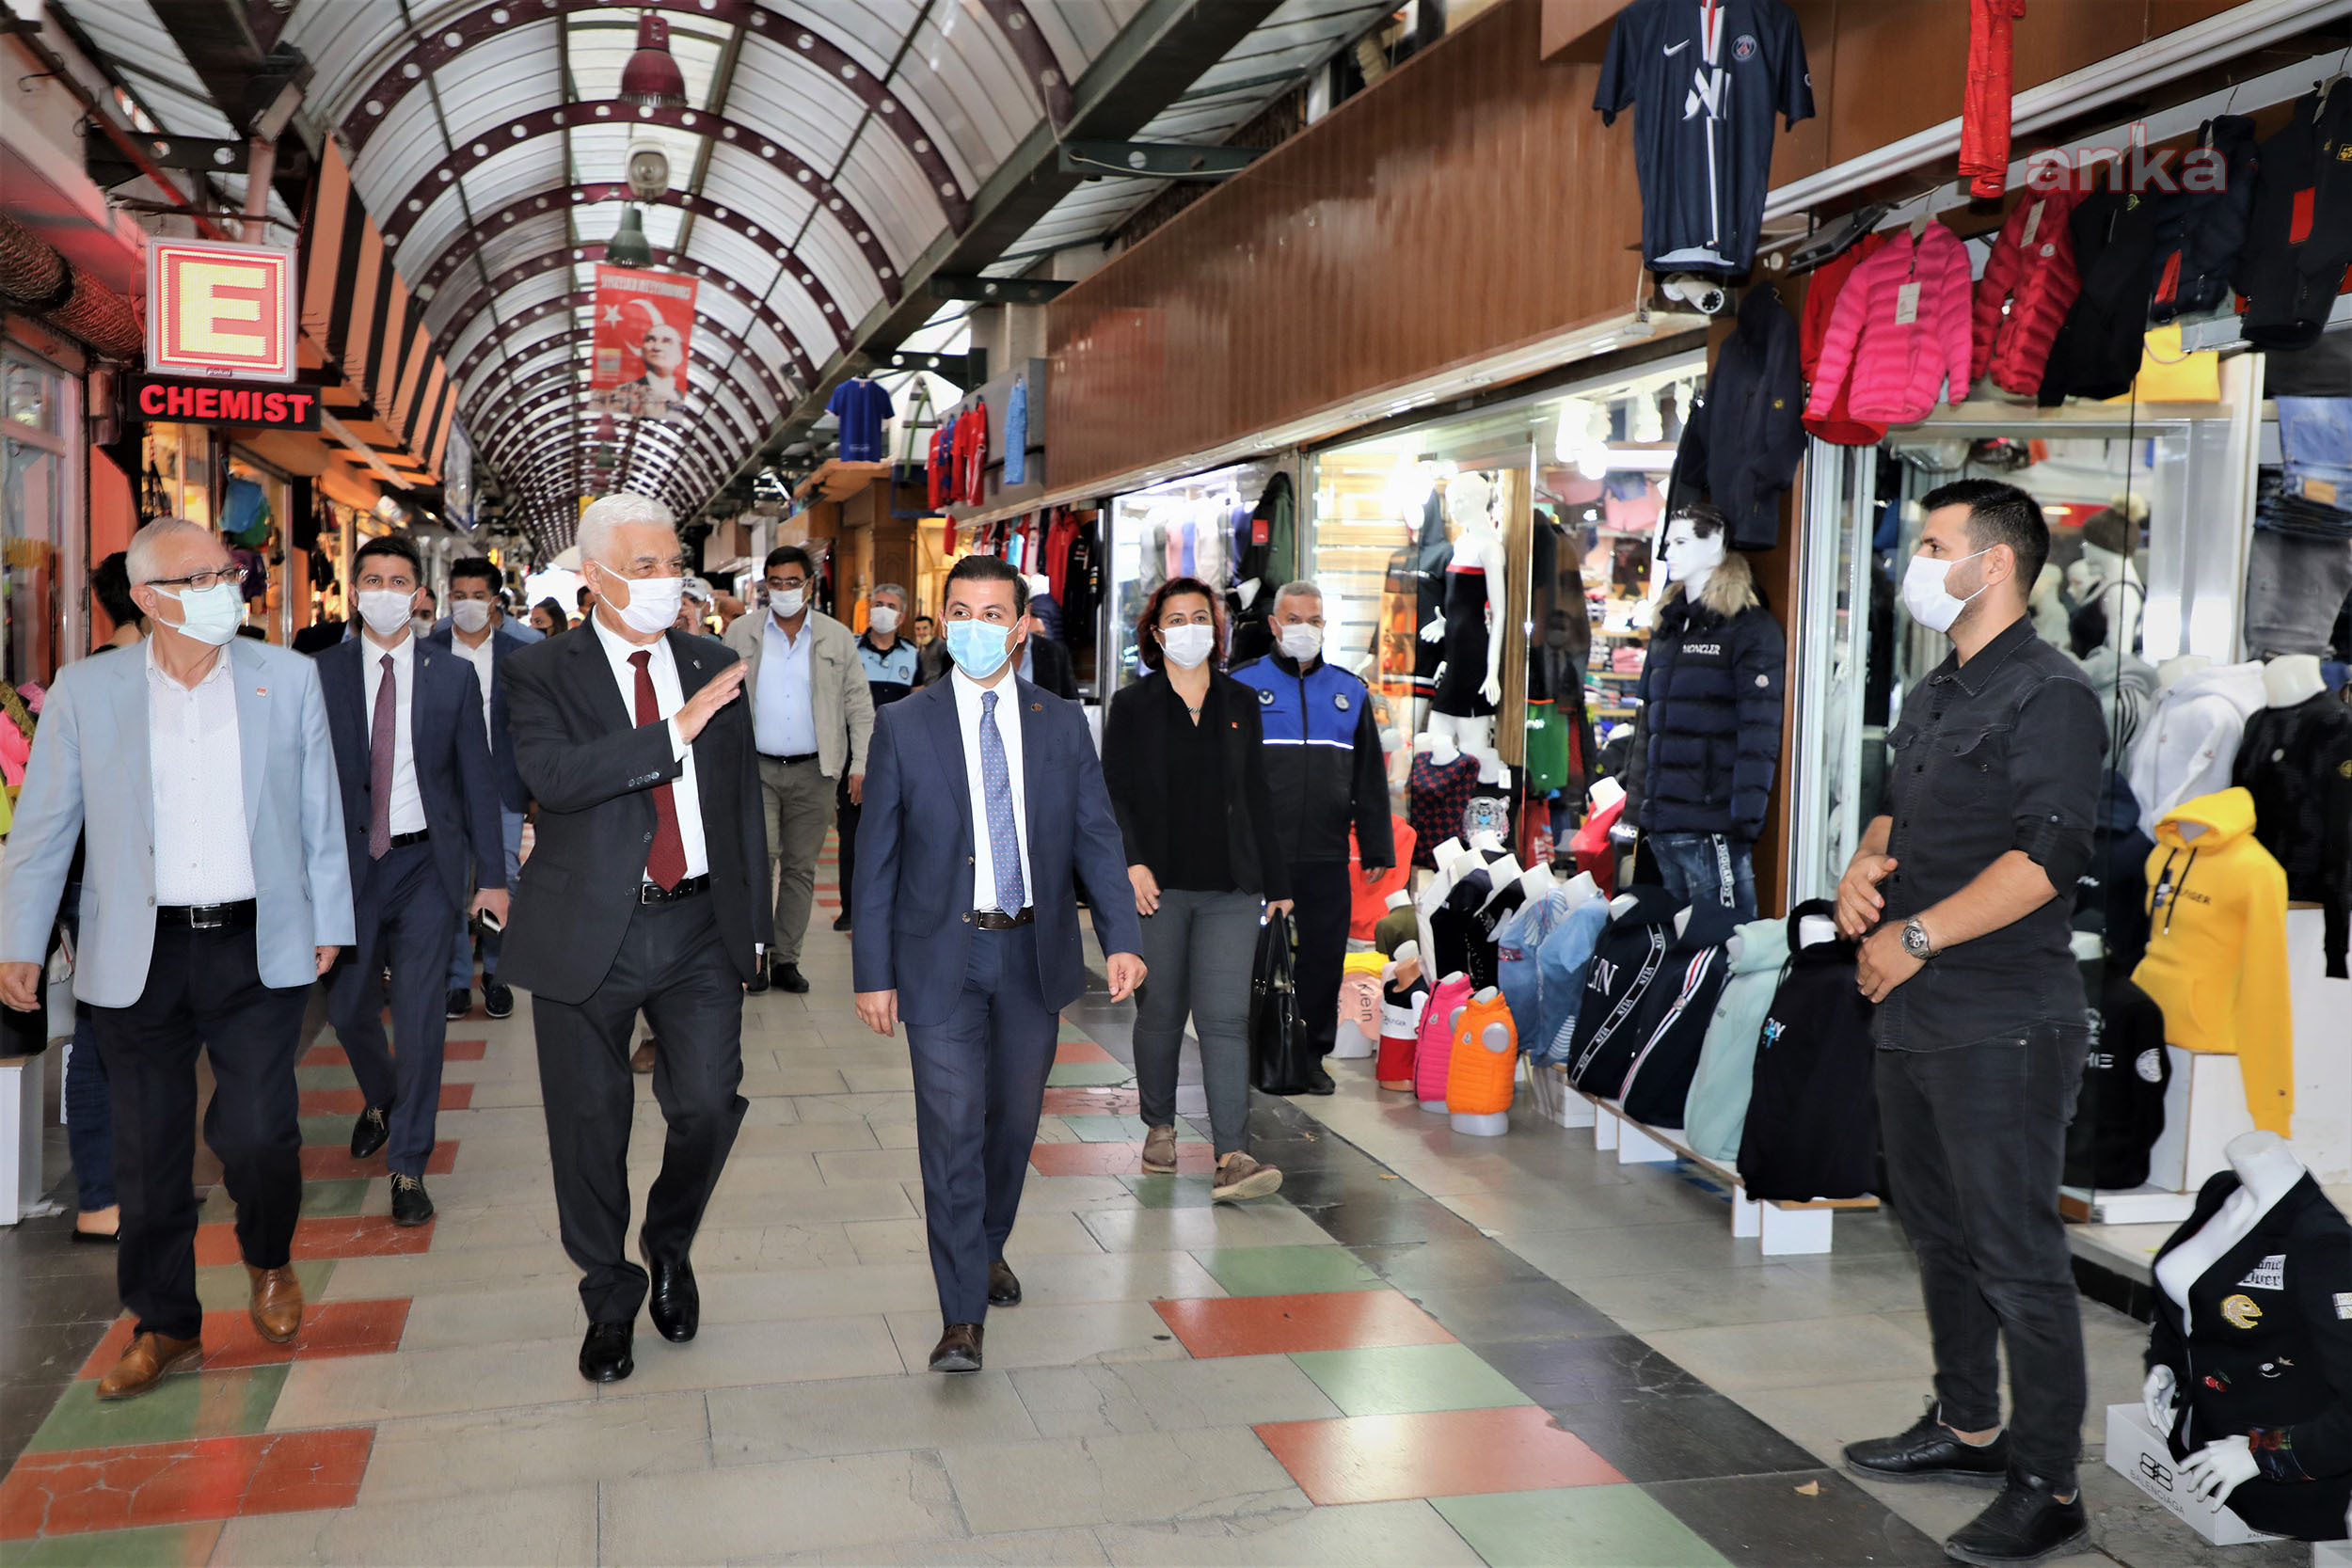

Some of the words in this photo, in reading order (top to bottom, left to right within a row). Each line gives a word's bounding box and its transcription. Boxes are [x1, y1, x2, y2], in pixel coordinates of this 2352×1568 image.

[179, 261, 266, 357] E
[139, 384, 314, 423] CHEMIST
[1358, 984, 1374, 1022] Klein
[2129, 1469, 2185, 1515] BALENCIAGA
